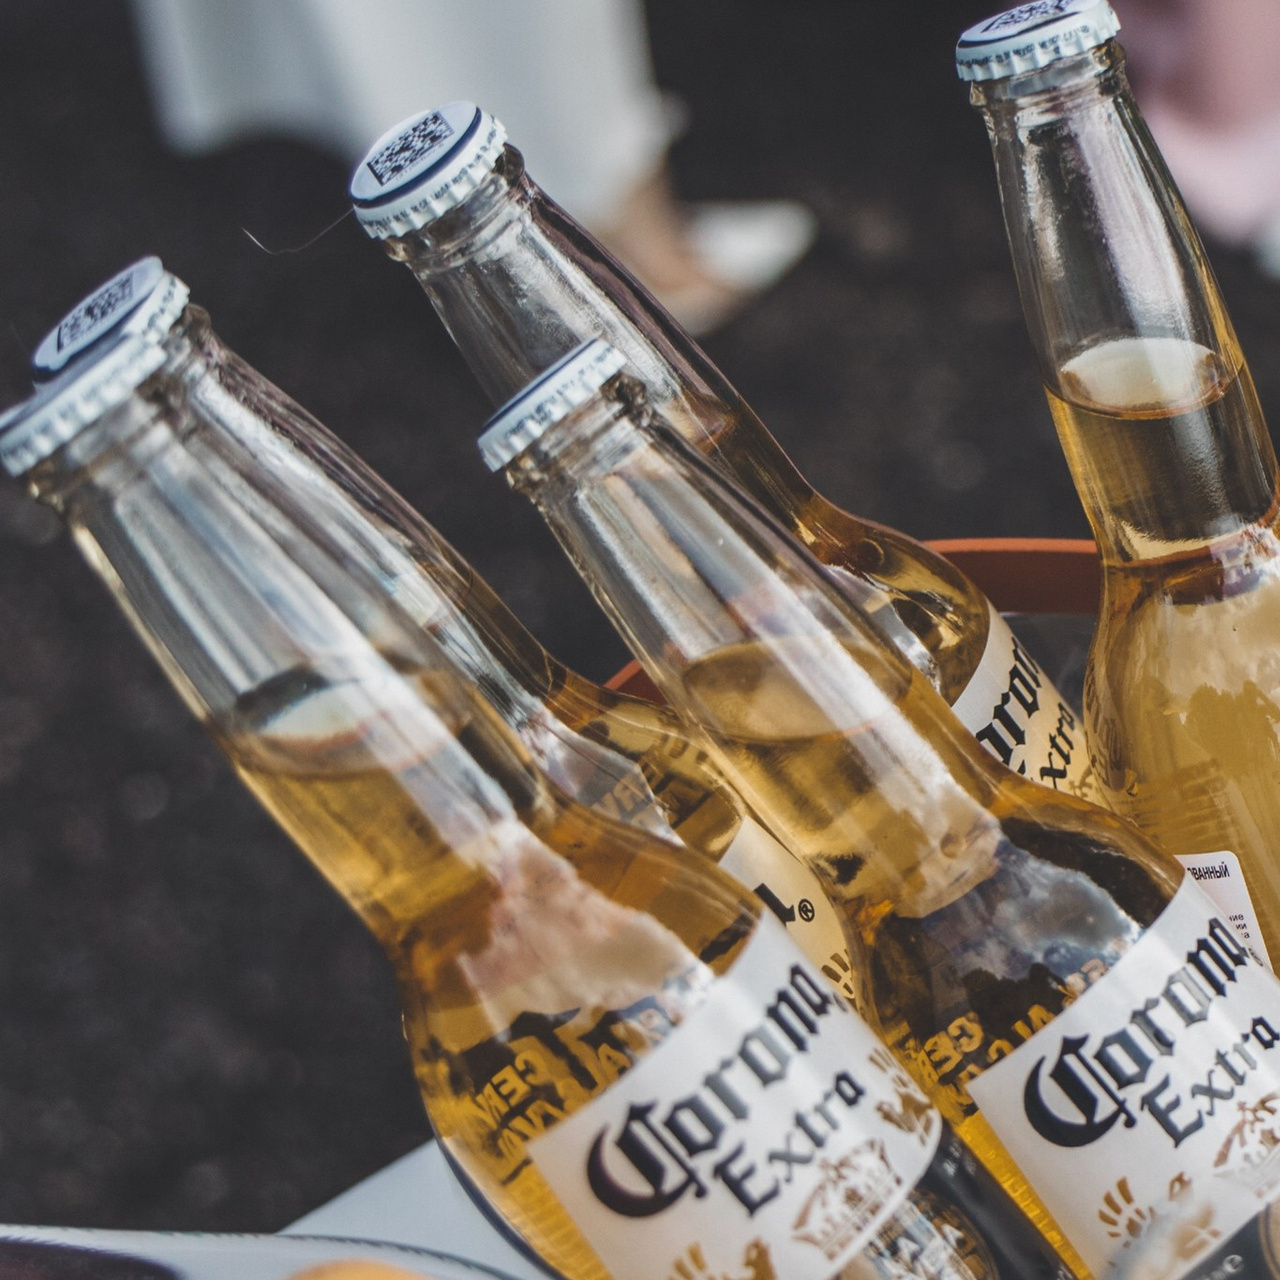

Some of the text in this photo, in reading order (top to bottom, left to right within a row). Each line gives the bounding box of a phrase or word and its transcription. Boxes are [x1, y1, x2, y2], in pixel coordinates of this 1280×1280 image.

[586, 963, 836, 1218] Corona
[713, 1069, 868, 1218] Extra
[1022, 916, 1253, 1148] Corona
